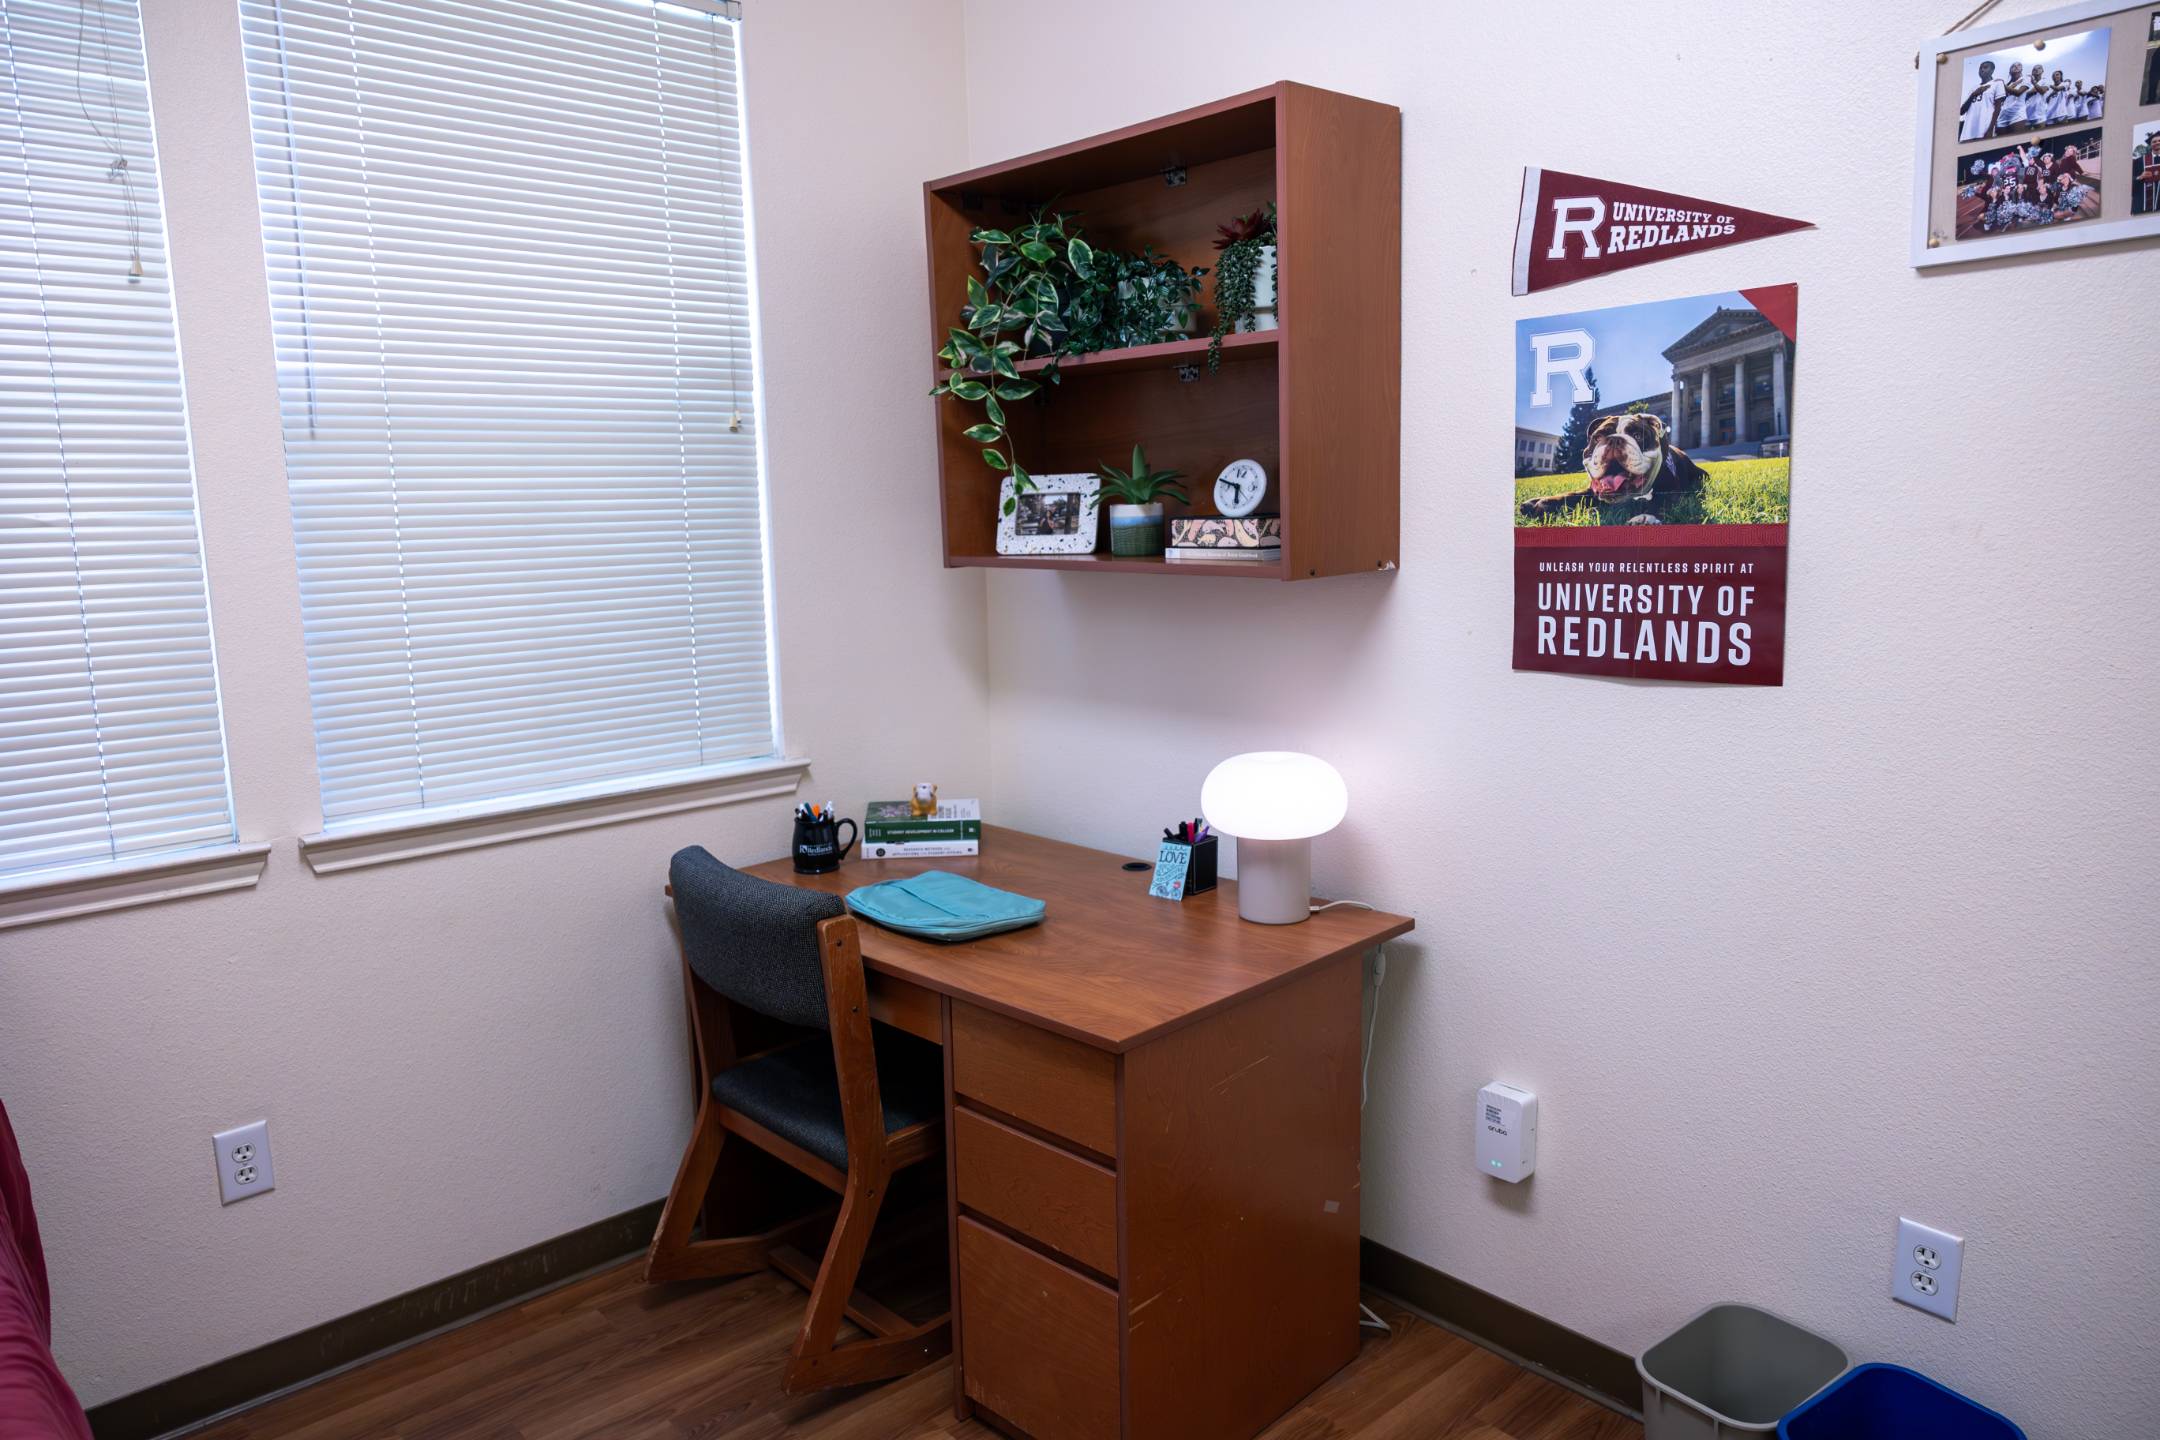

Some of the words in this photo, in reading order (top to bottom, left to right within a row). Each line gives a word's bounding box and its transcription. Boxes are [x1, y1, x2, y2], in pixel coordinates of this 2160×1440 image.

[1548, 197, 1606, 259] R
[1612, 201, 1712, 224] UNIVERSITY
[1716, 215, 1735, 225] OF
[1607, 224, 1736, 254] REDLANDS
[1529, 328, 1596, 408] R
[1539, 562, 1584, 572] UNLEASH
[1589, 562, 1615, 573] YOUR
[1619, 562, 1688, 574] RELENTLESS
[1694, 562, 1734, 574] SPIRIT
[1740, 563, 1754, 574] AT
[1538, 582, 1704, 615] UNIVERSITY
[1717, 585, 1755, 616] OF
[1538, 615, 1752, 666] REDLANDS
[1159, 850, 1187, 865] LOVE
[1487, 1125, 1508, 1136] aruba
